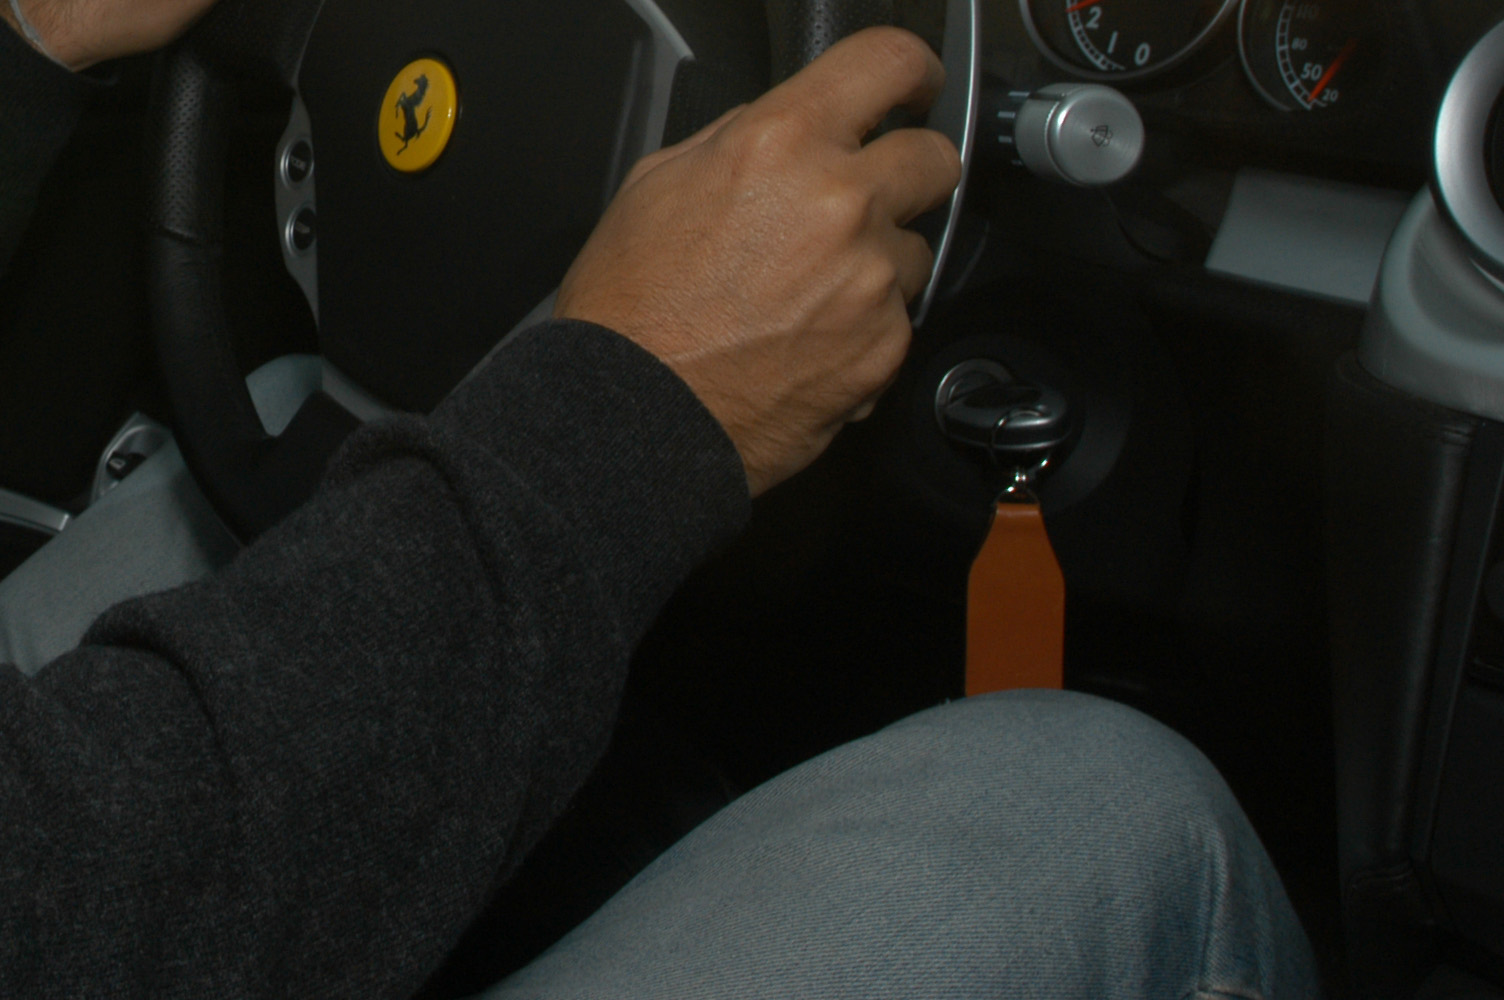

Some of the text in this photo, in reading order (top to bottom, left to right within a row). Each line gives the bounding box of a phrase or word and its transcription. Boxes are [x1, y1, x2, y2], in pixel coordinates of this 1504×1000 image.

[1086, 5, 1102, 29] 2
[1107, 30, 1119, 54] 1
[1291, 37, 1308, 51] 80
[1134, 41, 1151, 67] 0
[1300, 62, 1323, 81] 50
[1322, 87, 1340, 104] 20
